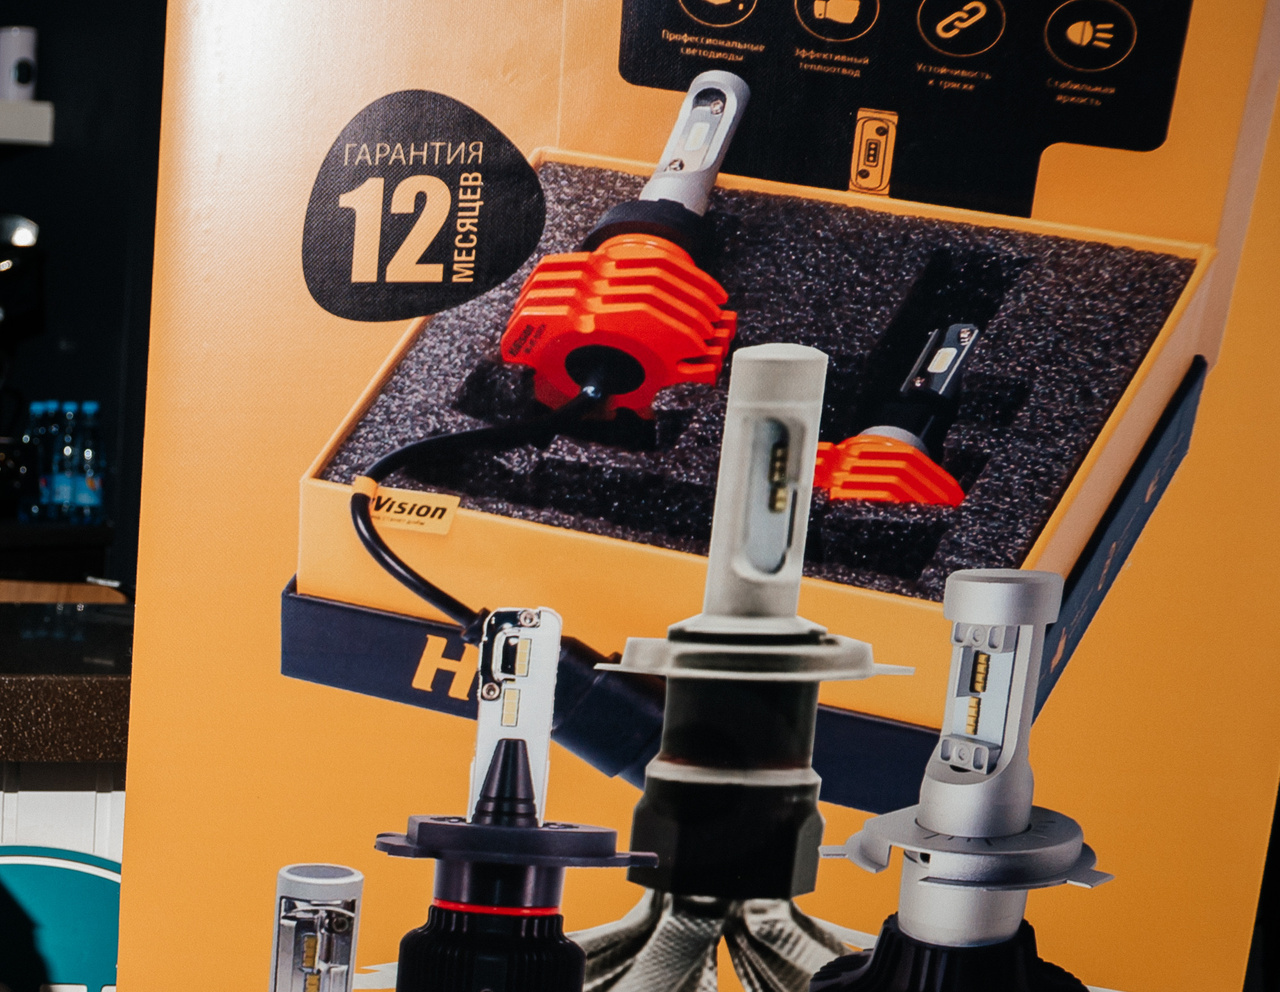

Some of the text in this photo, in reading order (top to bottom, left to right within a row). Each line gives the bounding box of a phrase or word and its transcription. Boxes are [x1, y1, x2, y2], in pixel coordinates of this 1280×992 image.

[661, 28, 766, 52] Профессиональные
[680, 46, 744, 62] светодиоды
[794, 47, 870, 65] Эффективный
[799, 62, 861, 78] теплоотвод
[343, 141, 484, 166] ГАРАНТИЯ
[338, 174, 452, 283] 12
[452, 172, 484, 283] МЕСЯЦЕВ
[372, 495, 448, 520] Vision
